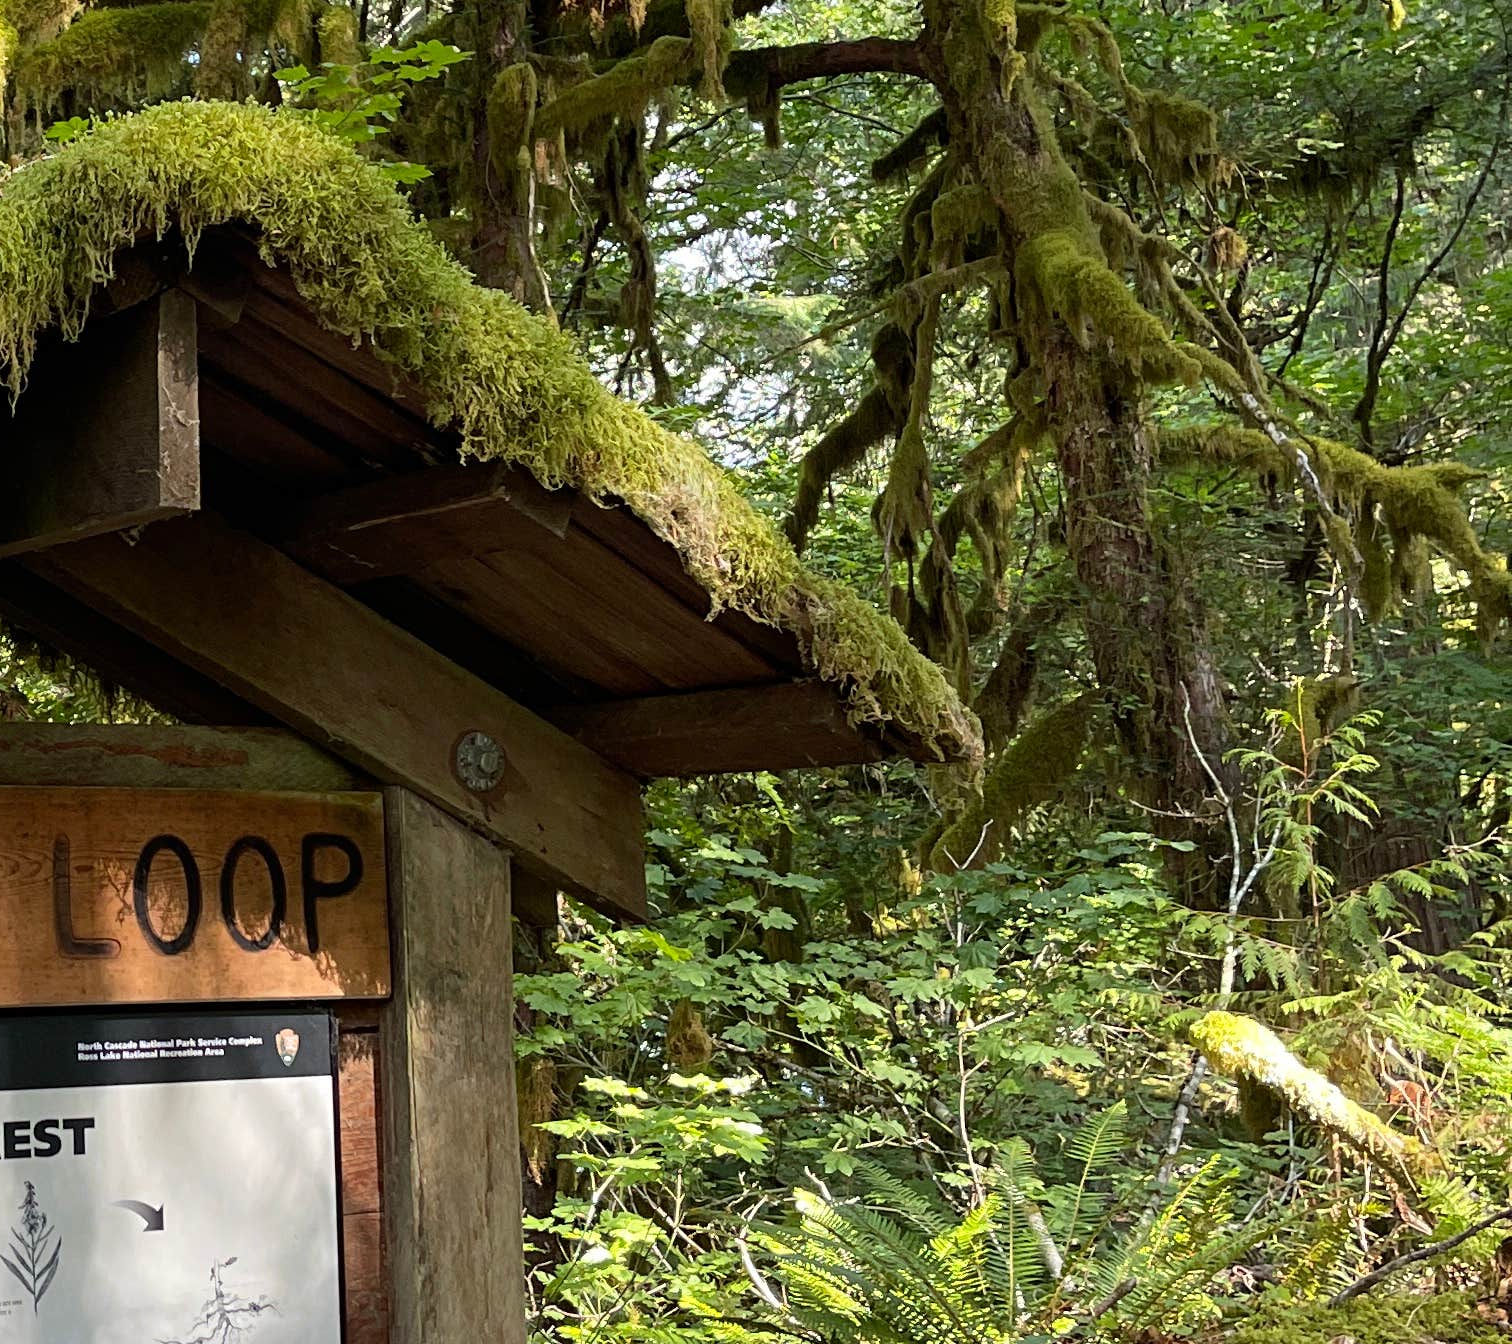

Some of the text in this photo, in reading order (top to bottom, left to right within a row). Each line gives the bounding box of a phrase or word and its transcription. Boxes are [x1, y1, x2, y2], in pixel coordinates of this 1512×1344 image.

[54, 832, 365, 960] LOOP
[77, 1041, 103, 1051] North
[138, 1038, 175, 1049] National
[175, 1037, 197, 1048] Park
[197, 1037, 227, 1048] Service
[227, 1035, 264, 1047] Complex
[77, 1047, 225, 1061] Ross Lake National Recreation Area
